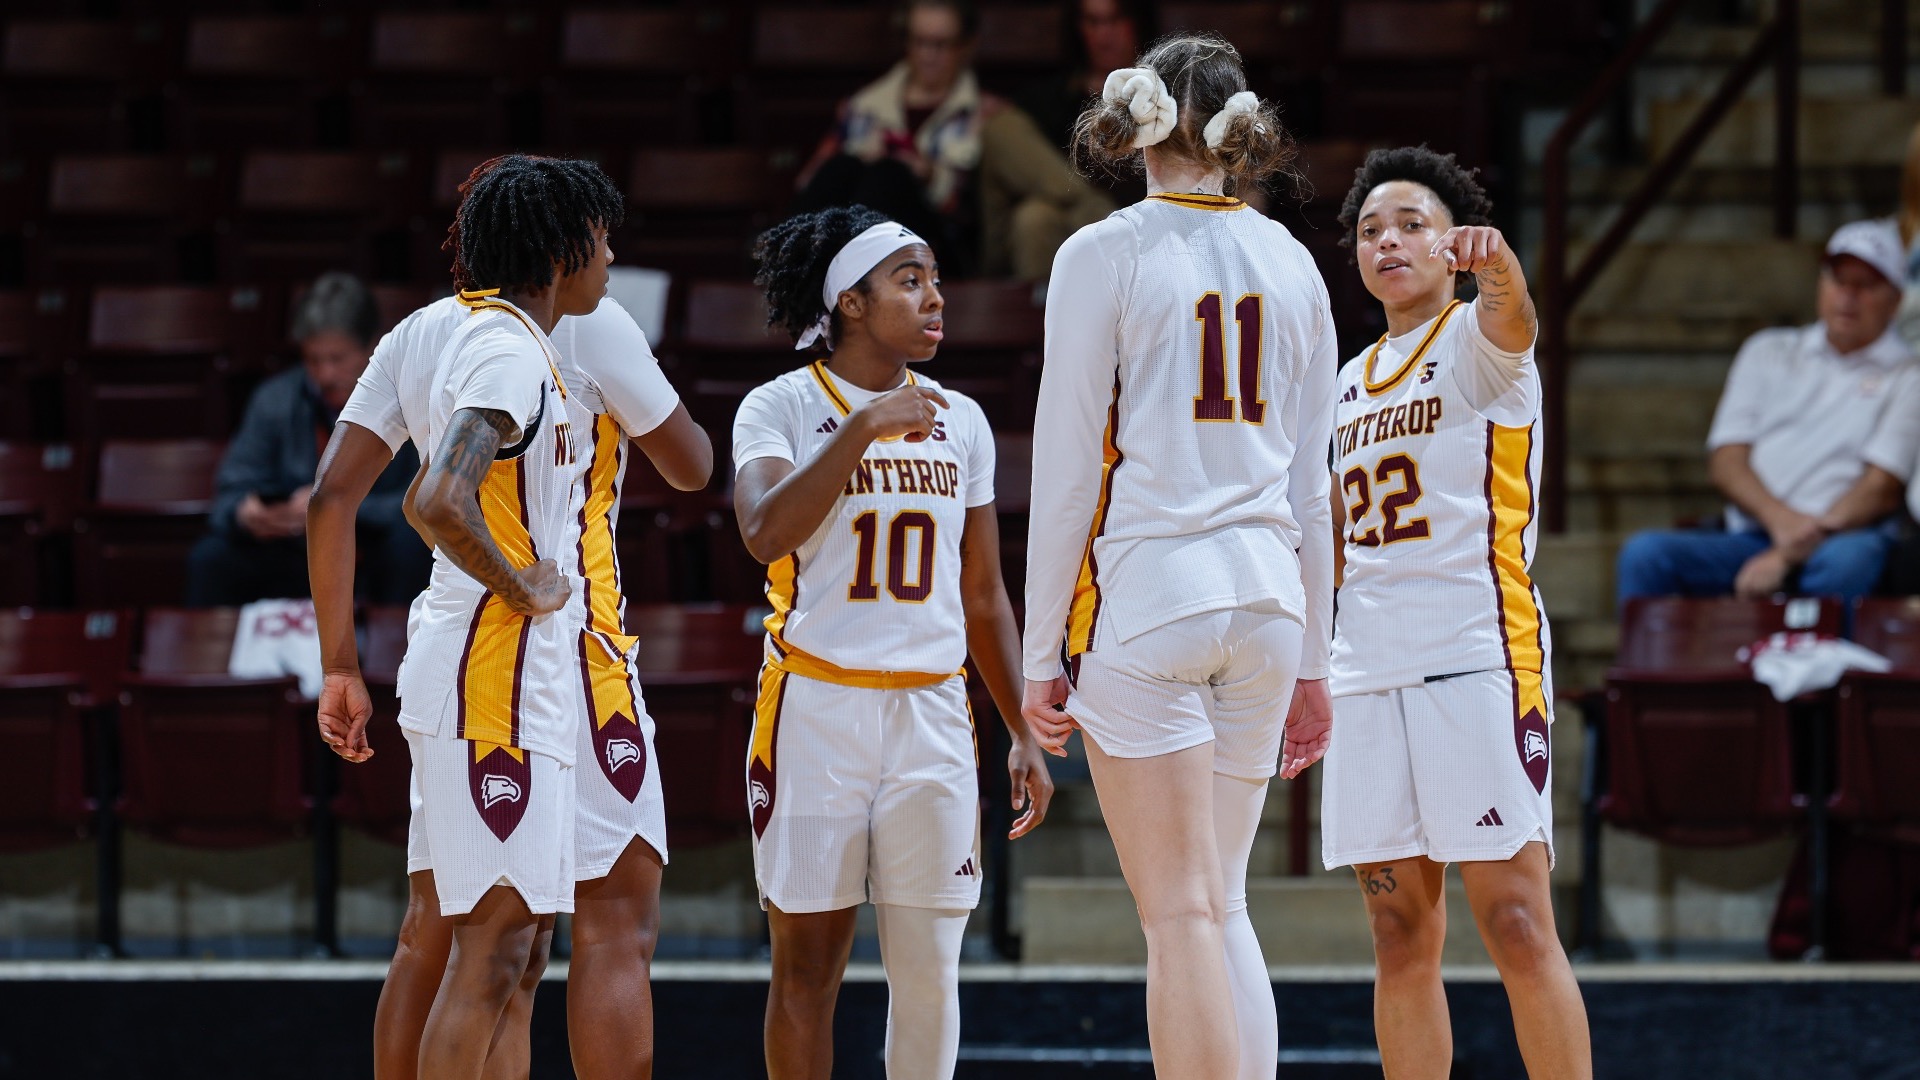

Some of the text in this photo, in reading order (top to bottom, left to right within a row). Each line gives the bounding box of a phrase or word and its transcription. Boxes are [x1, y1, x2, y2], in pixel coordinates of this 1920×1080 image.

[1193, 290, 1267, 426] 11
[1343, 451, 1432, 547] 22
[846, 509, 938, 604] 10
